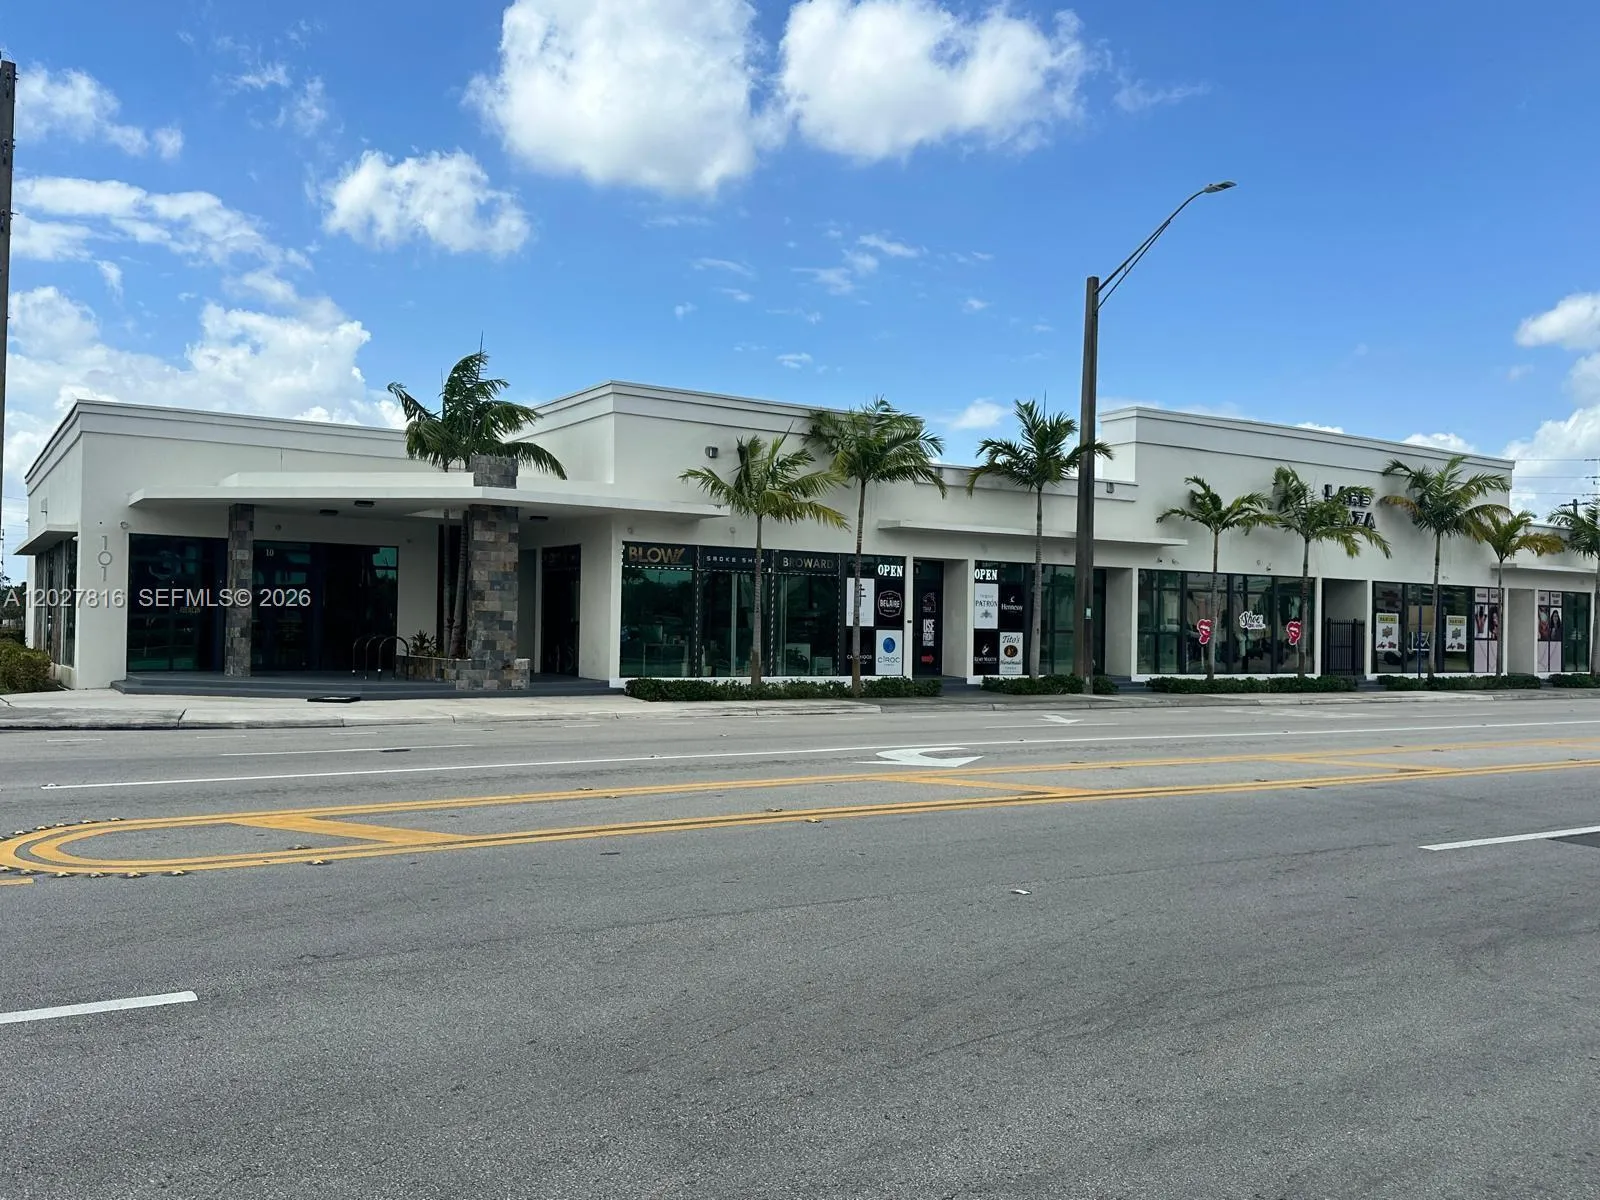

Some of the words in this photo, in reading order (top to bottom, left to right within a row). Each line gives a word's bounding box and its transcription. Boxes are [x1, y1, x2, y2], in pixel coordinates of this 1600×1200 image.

[97, 535, 113, 582] 101
[782, 557, 835, 569] BROWARD
[877, 564, 904, 577] OPEN
[974, 568, 998, 580] OPEN
[1002, 635, 1020, 643] Tito's
